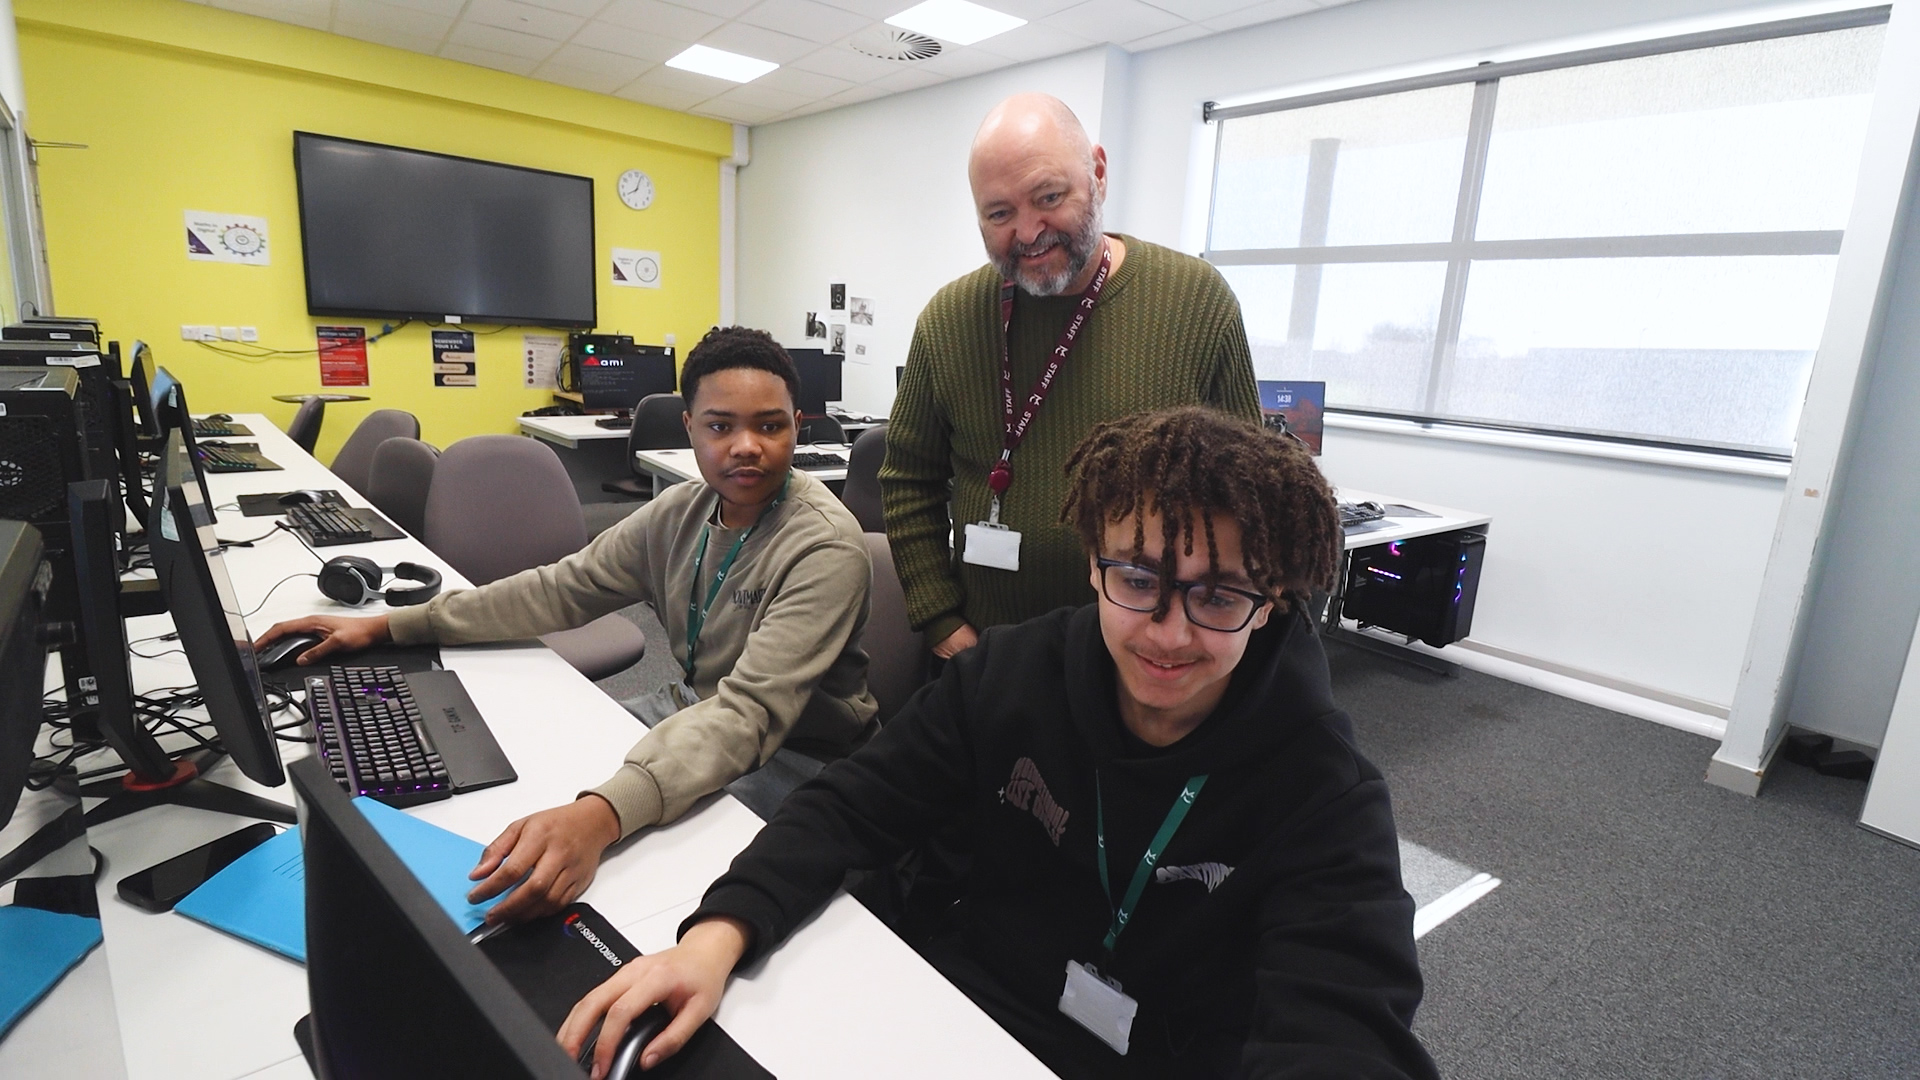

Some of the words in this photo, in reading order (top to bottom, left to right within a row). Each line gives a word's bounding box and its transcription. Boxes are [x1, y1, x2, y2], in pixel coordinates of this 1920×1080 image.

[1092, 266, 1108, 293] STAFF
[1066, 314, 1083, 341] STAFF
[600, 359, 624, 367] ami
[1041, 362, 1058, 390] STAFF
[1015, 411, 1032, 437] STAFF
[580, 927, 623, 967] OVERCLOCKERS
